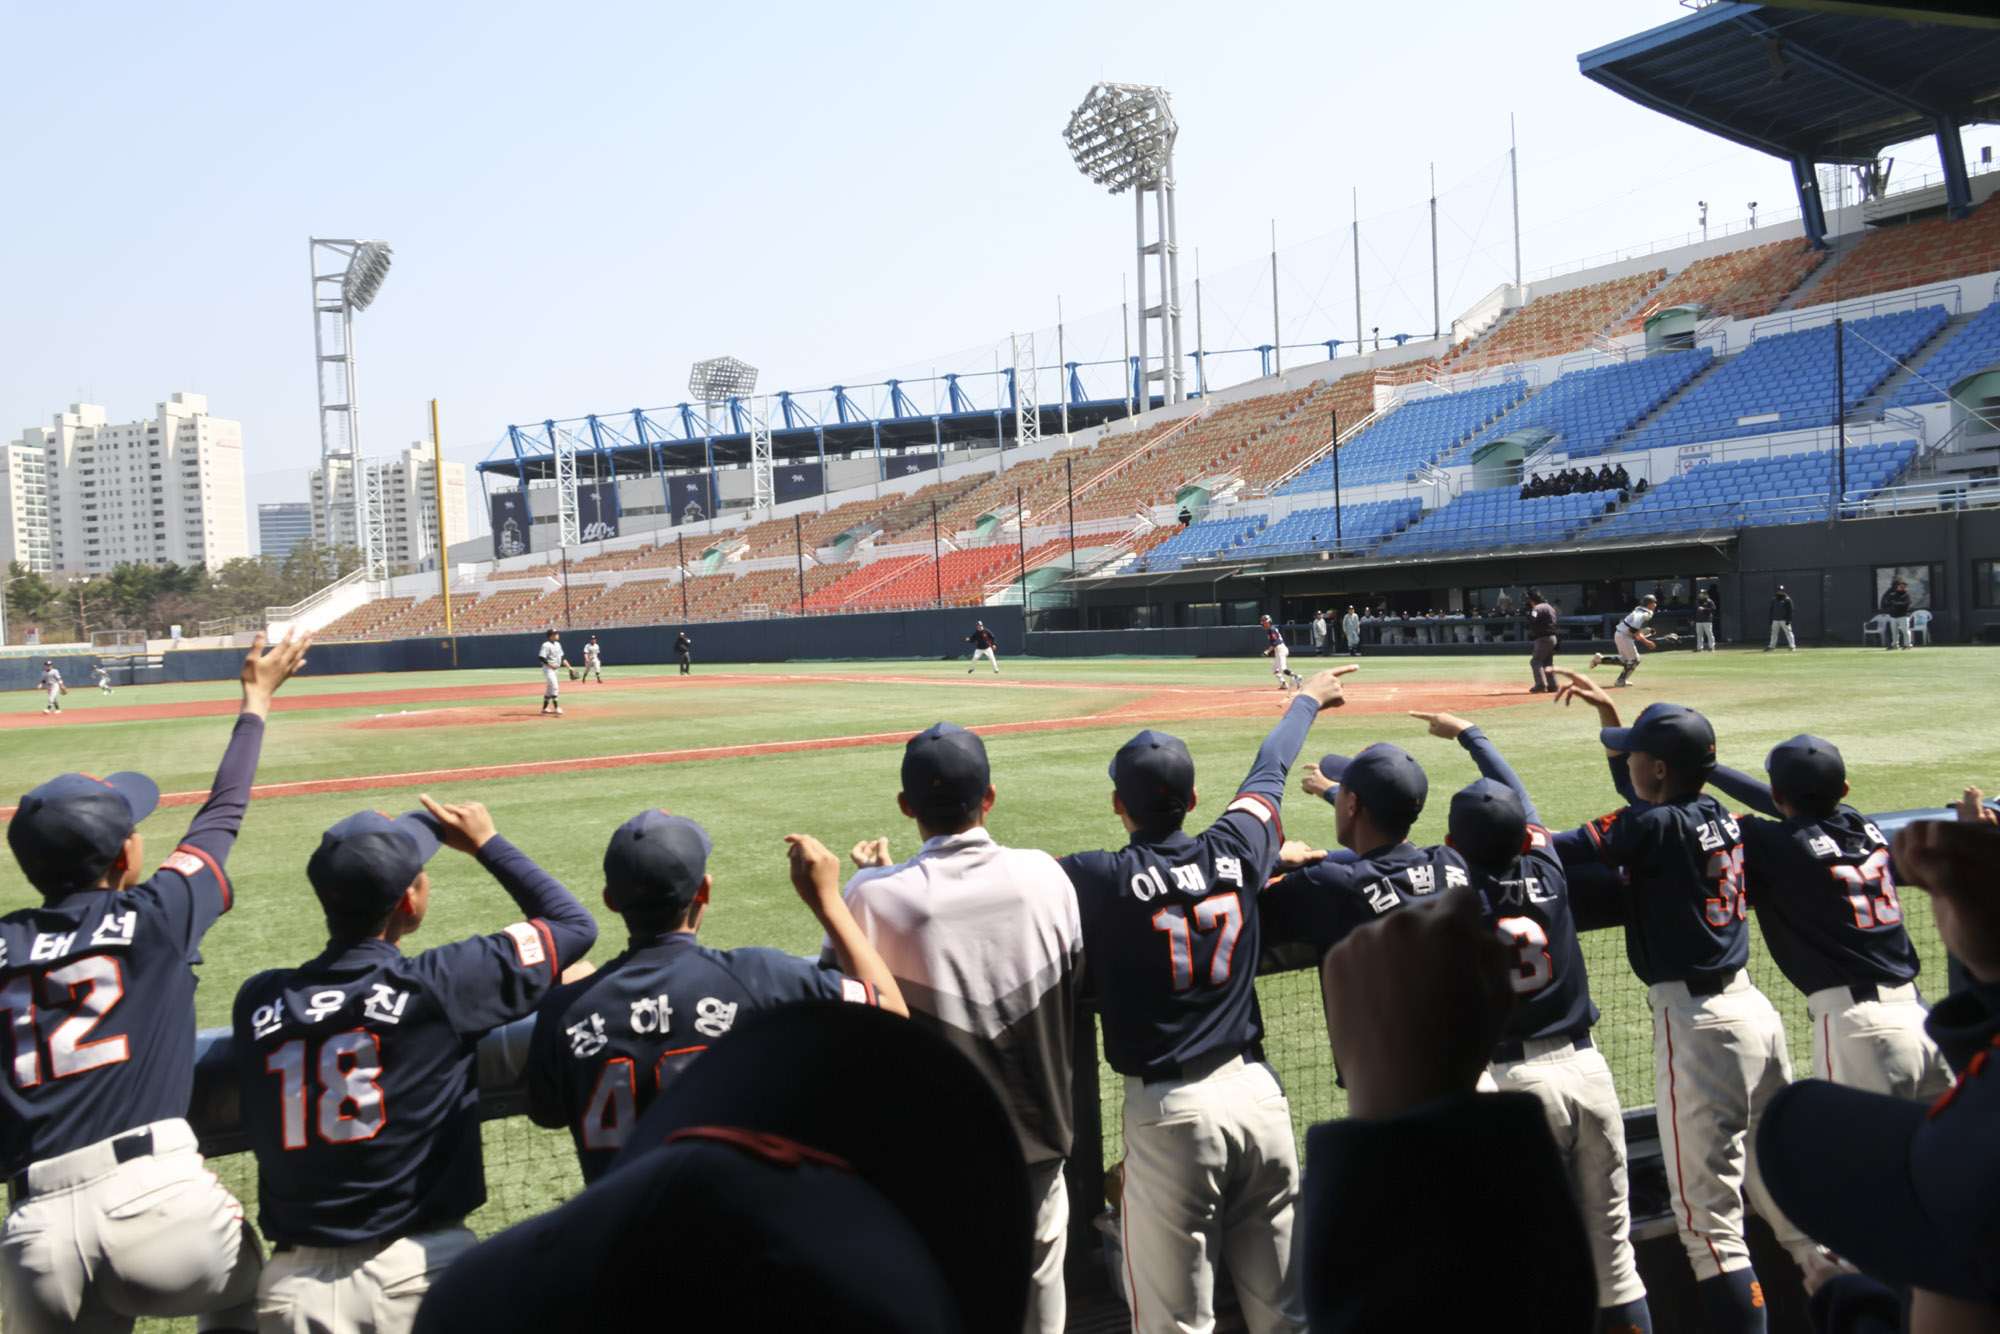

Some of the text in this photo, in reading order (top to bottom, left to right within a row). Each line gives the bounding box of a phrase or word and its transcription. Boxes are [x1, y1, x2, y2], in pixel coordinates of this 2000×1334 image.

[1830, 848, 1901, 929] 13
[0, 911, 137, 968] 태선
[1151, 891, 1244, 992] 17
[0, 955, 130, 1089] 12
[252, 983, 410, 1041] 안우진
[266, 1027, 387, 1151] 18
